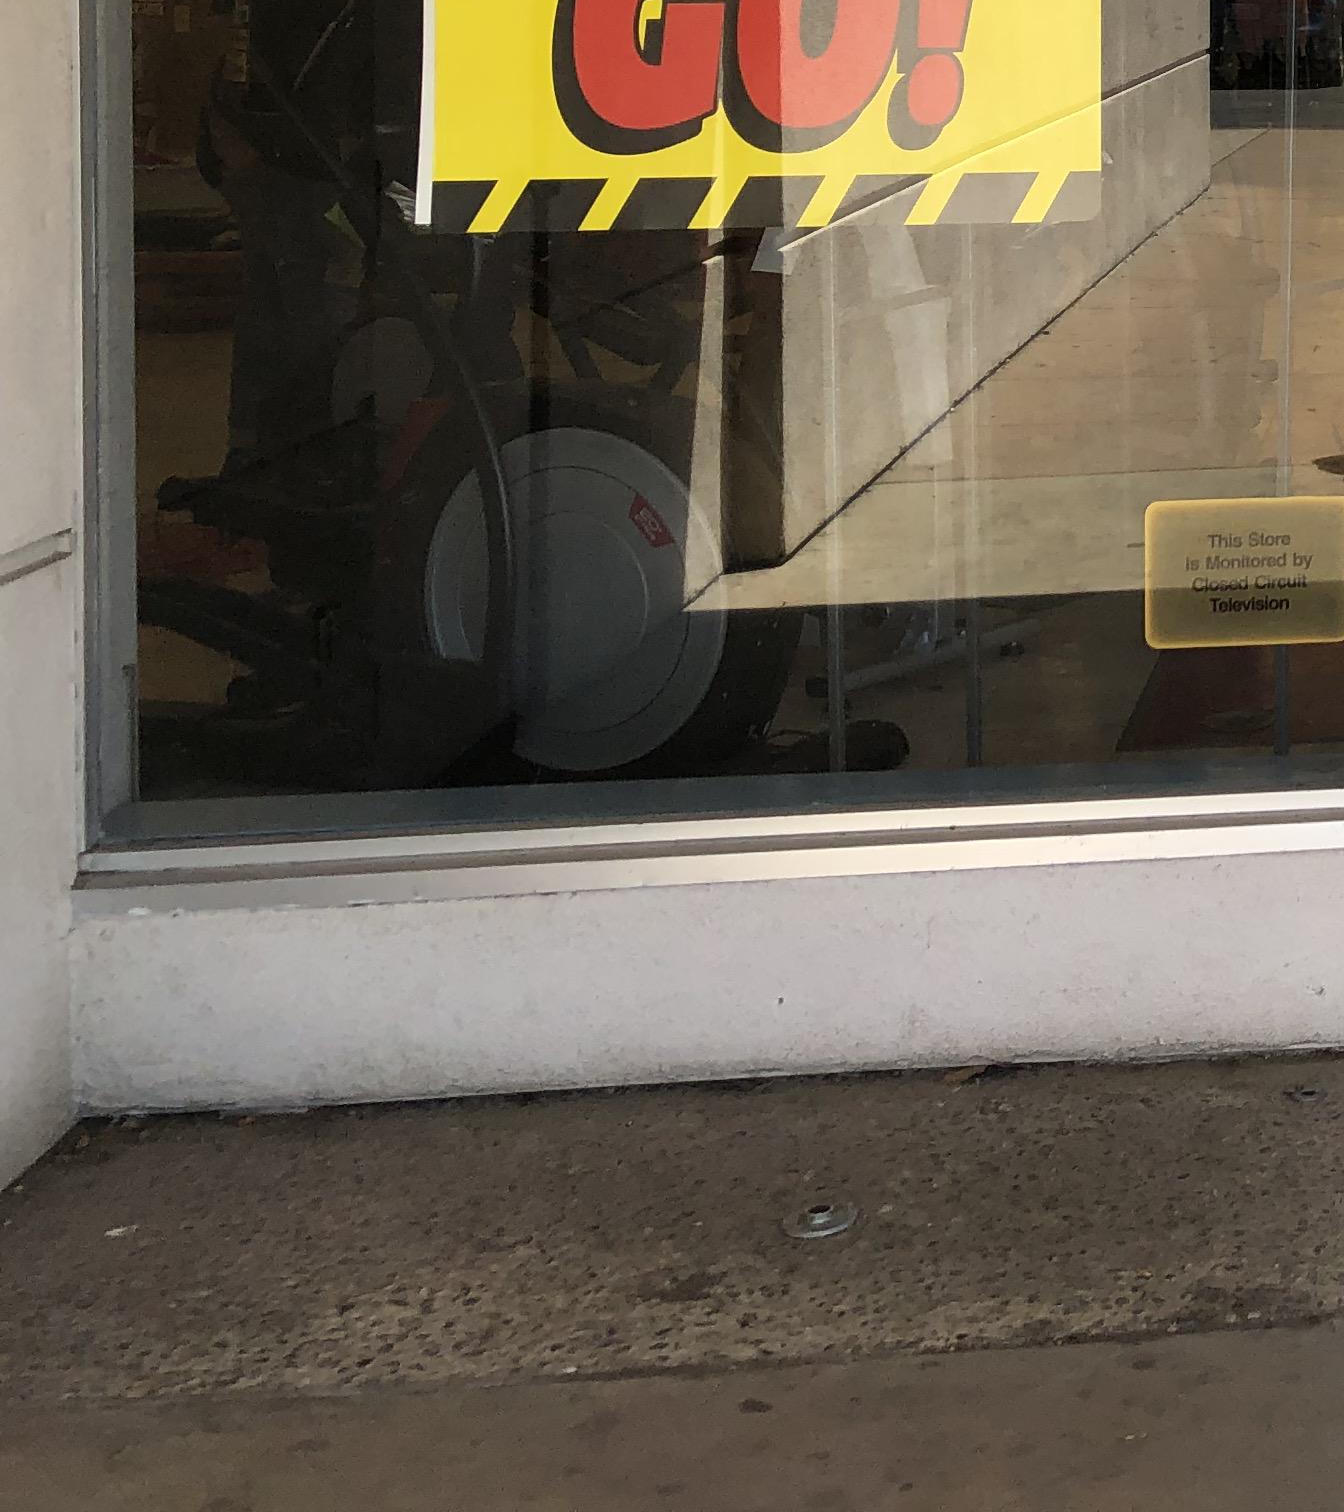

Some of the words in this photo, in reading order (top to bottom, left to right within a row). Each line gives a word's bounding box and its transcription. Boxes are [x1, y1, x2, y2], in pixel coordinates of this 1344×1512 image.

[1207, 534, 1242, 548] This
[1248, 532, 1291, 547] Store
[1205, 553, 1287, 570] Monitored
[1292, 552, 1313, 570] by
[1192, 576, 1249, 592] Closed
[1254, 574, 1307, 590] Circuit
[1209, 596, 1290, 613] Television
